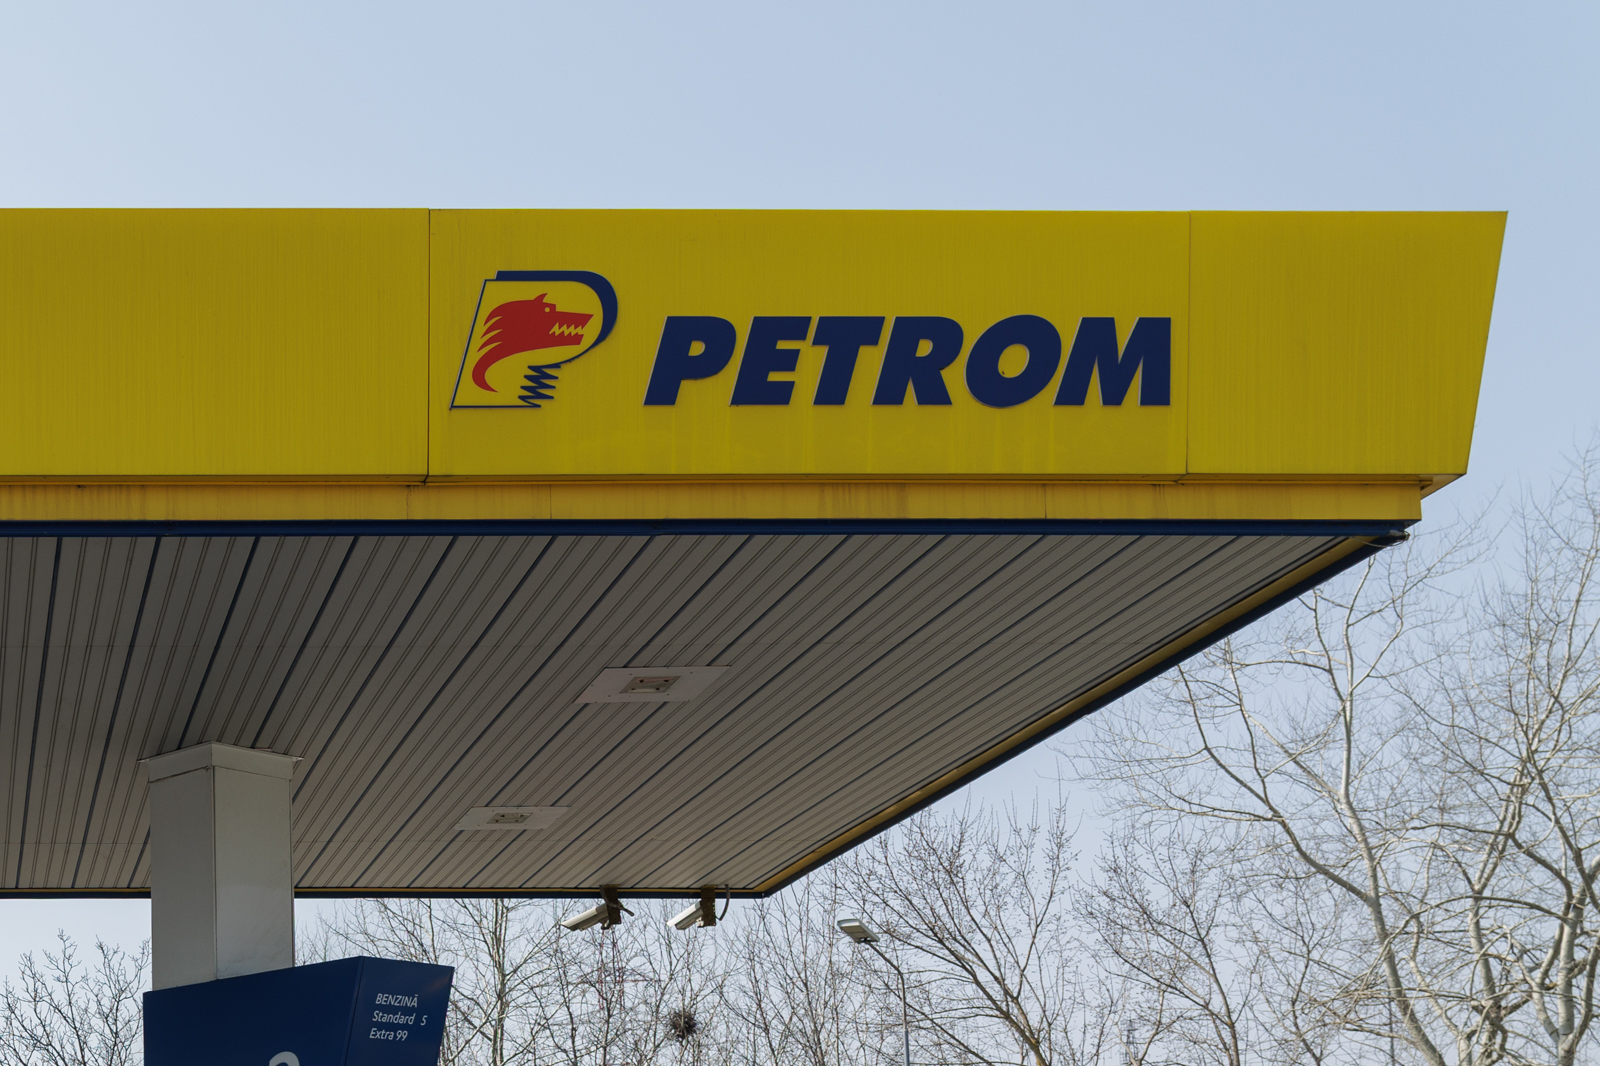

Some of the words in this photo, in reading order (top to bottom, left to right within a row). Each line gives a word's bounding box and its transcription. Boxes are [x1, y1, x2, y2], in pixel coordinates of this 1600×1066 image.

[643, 315, 1172, 410] PETROM
[375, 993, 419, 1008] BENZINĂ
[372, 1010, 416, 1025] Standard
[369, 1028, 394, 1041] Extra
[396, 1030, 408, 1042] 99
